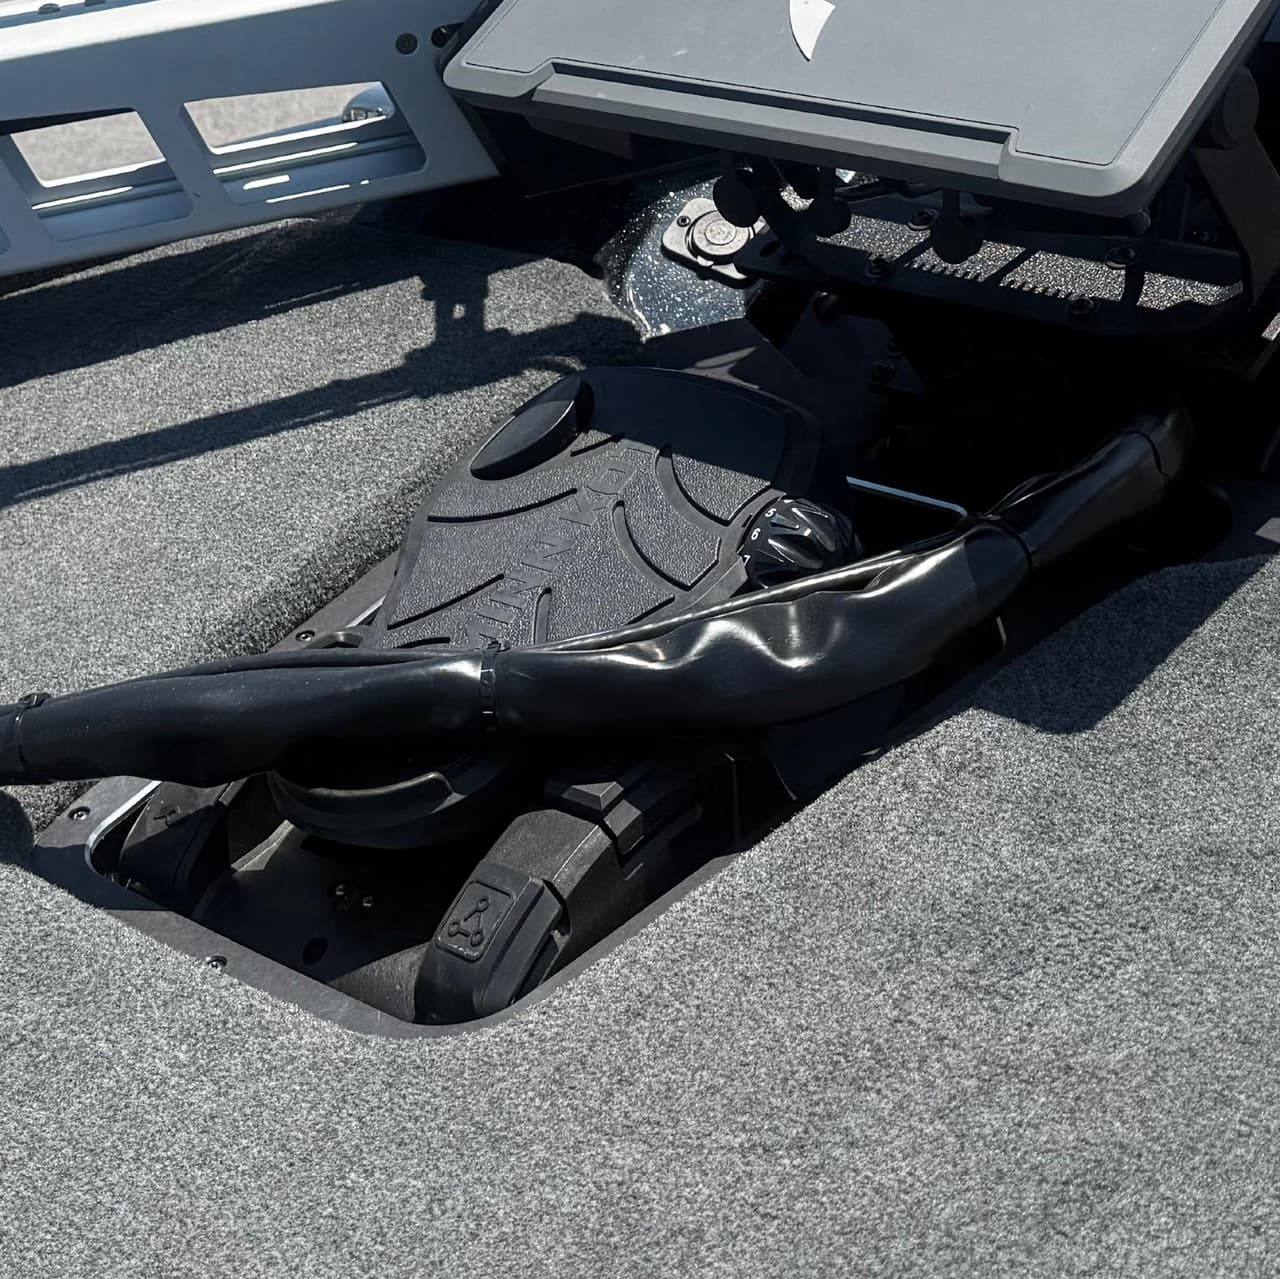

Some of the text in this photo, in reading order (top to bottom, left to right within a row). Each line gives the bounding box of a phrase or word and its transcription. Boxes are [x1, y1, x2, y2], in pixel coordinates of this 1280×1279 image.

[743, 508, 777, 568] 5 6 7
